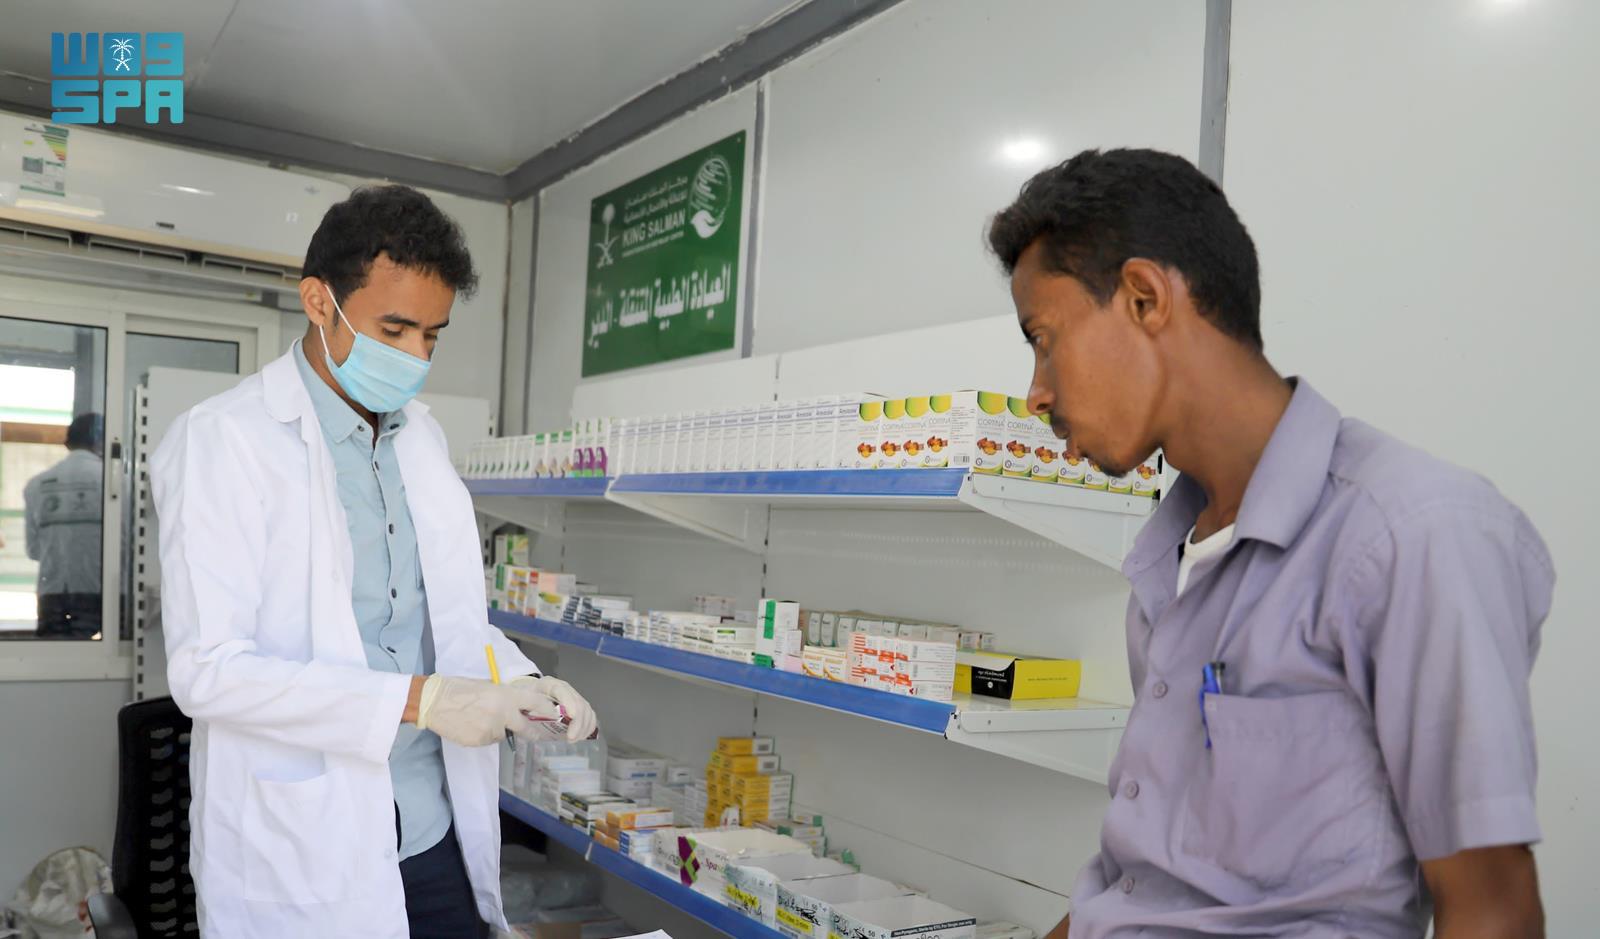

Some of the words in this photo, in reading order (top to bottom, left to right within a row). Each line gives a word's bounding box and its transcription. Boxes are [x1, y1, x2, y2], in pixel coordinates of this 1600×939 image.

[622, 222, 646, 248] KING
[648, 207, 686, 239] SALMAN
[654, 275, 690, 331] الطبية
[690, 263, 731, 320] العيادة
